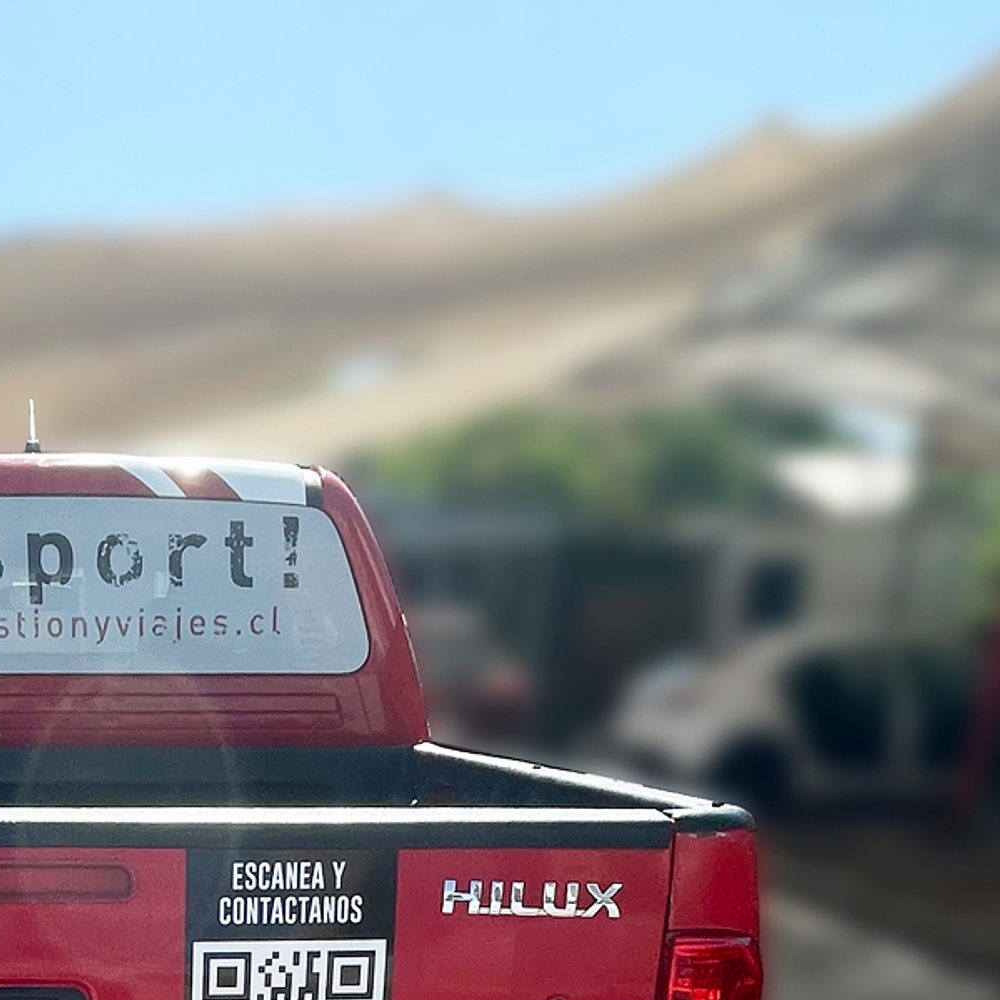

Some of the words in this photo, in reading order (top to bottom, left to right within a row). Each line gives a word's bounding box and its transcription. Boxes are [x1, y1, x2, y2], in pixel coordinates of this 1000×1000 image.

[232, 861, 325, 890] ESCANEA
[331, 861, 346, 890] Y
[219, 895, 363, 924] CONTACTANOS
[442, 879, 623, 918] HILUX
